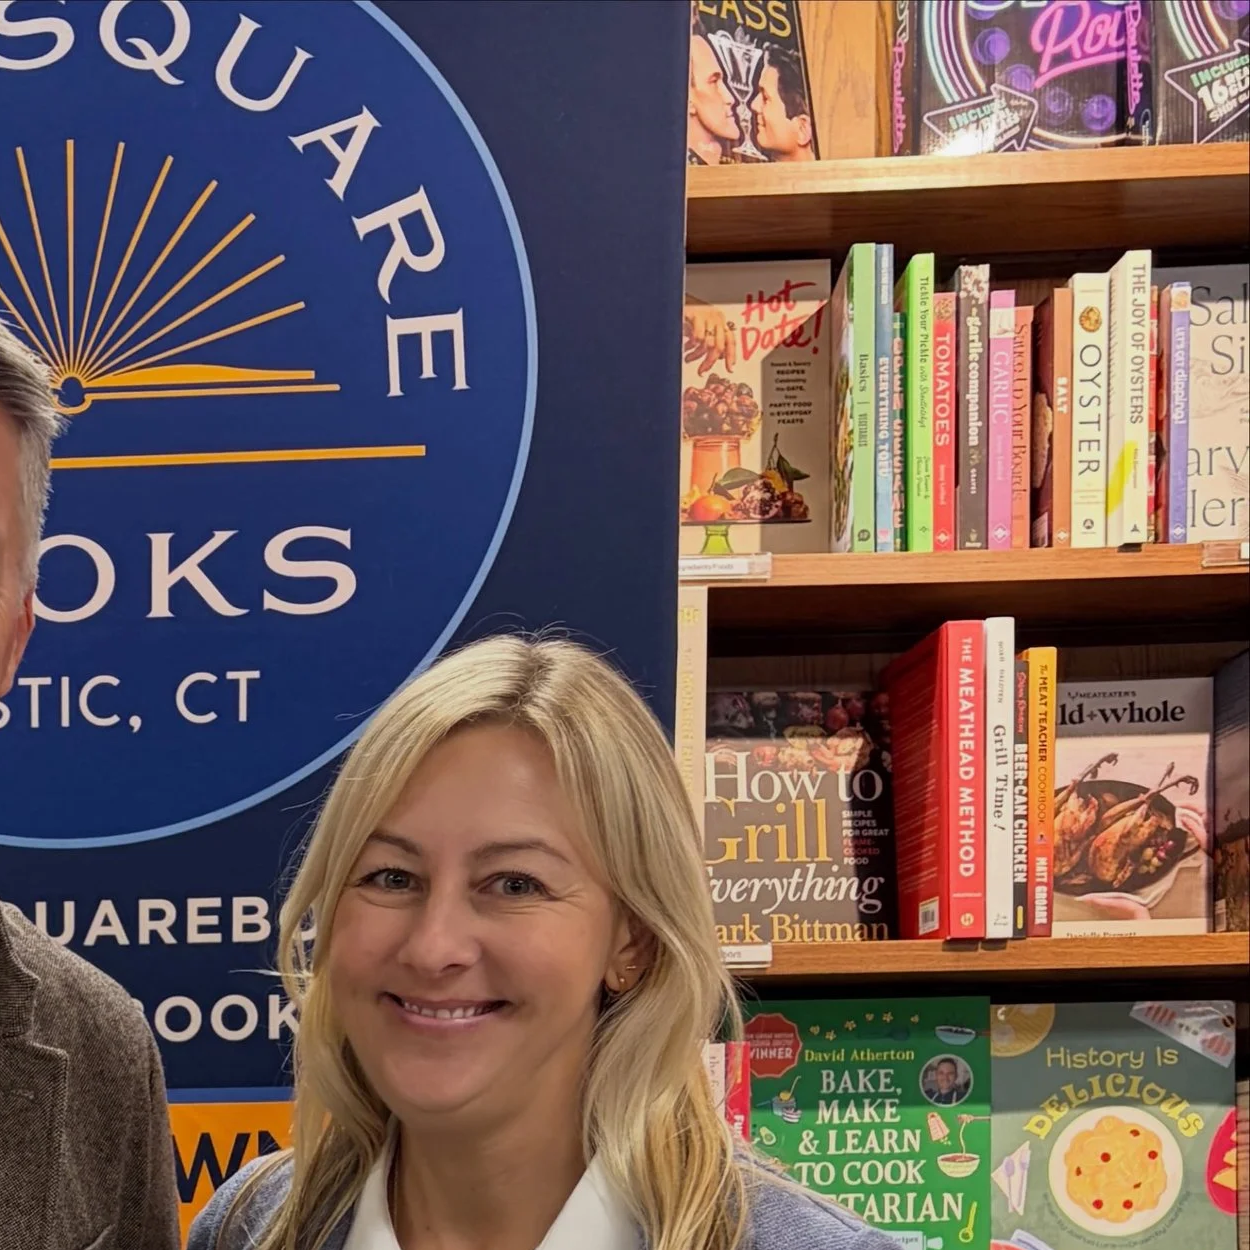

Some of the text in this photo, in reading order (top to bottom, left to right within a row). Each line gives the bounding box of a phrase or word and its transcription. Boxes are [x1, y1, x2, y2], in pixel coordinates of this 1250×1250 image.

[1197, 79, 1229, 112] 16
[742, 280, 817, 324] Hot
[919, 277, 930, 307] Tickle
[740, 300, 823, 360] Date!
[919, 308, 930, 333] Your
[919, 334, 930, 363] Pickle
[1130, 263, 1146, 424] THE JOY OF OYSTERS
[859, 354, 870, 392] Basics
[935, 332, 951, 446] TOMATOES
[993, 351, 1009, 425] GARLIC
[878, 357, 889, 440] EVERYTHING
[1057, 376, 1068, 415] SALT
[1078, 344, 1102, 477] OYSTER
[1174, 371, 1188, 425] dipping!
[1012, 404, 1028, 440] Your
[175, 670, 260, 723] CT
[958, 636, 975, 878] THE MEATHEAD METHOD
[993, 725, 1009, 767] Grill
[1037, 676, 1048, 826] MEAT TEACHER COOKBOOK
[704, 750, 883, 803] How to
[1013, 743, 1028, 815] BEER-CAN
[706, 796, 833, 865] Grill
[842, 810, 873, 818] SIMPLE
[842, 819, 877, 828] RECIPES
[842, 828, 889, 837] FOR GREAT
[843, 856, 869, 865] FOOD
[1013, 819, 1028, 883] CHICKEN
[708, 864, 885, 915] verything
[2, 896, 316, 946] UAREB
[770, 912, 888, 944] Bittman
[132, 994, 299, 1042] OOK
[805, 1048, 915, 1062] David Atherton
[1046, 1046, 1179, 1070] History Is
[820, 1068, 902, 1096] BAKE,
[816, 1098, 901, 1125] MAKE
[1023, 1072, 1204, 1140] DELICIOUS
[798, 1129, 921, 1155] & LEARN
[793, 1160, 926, 1187] TO COOK
